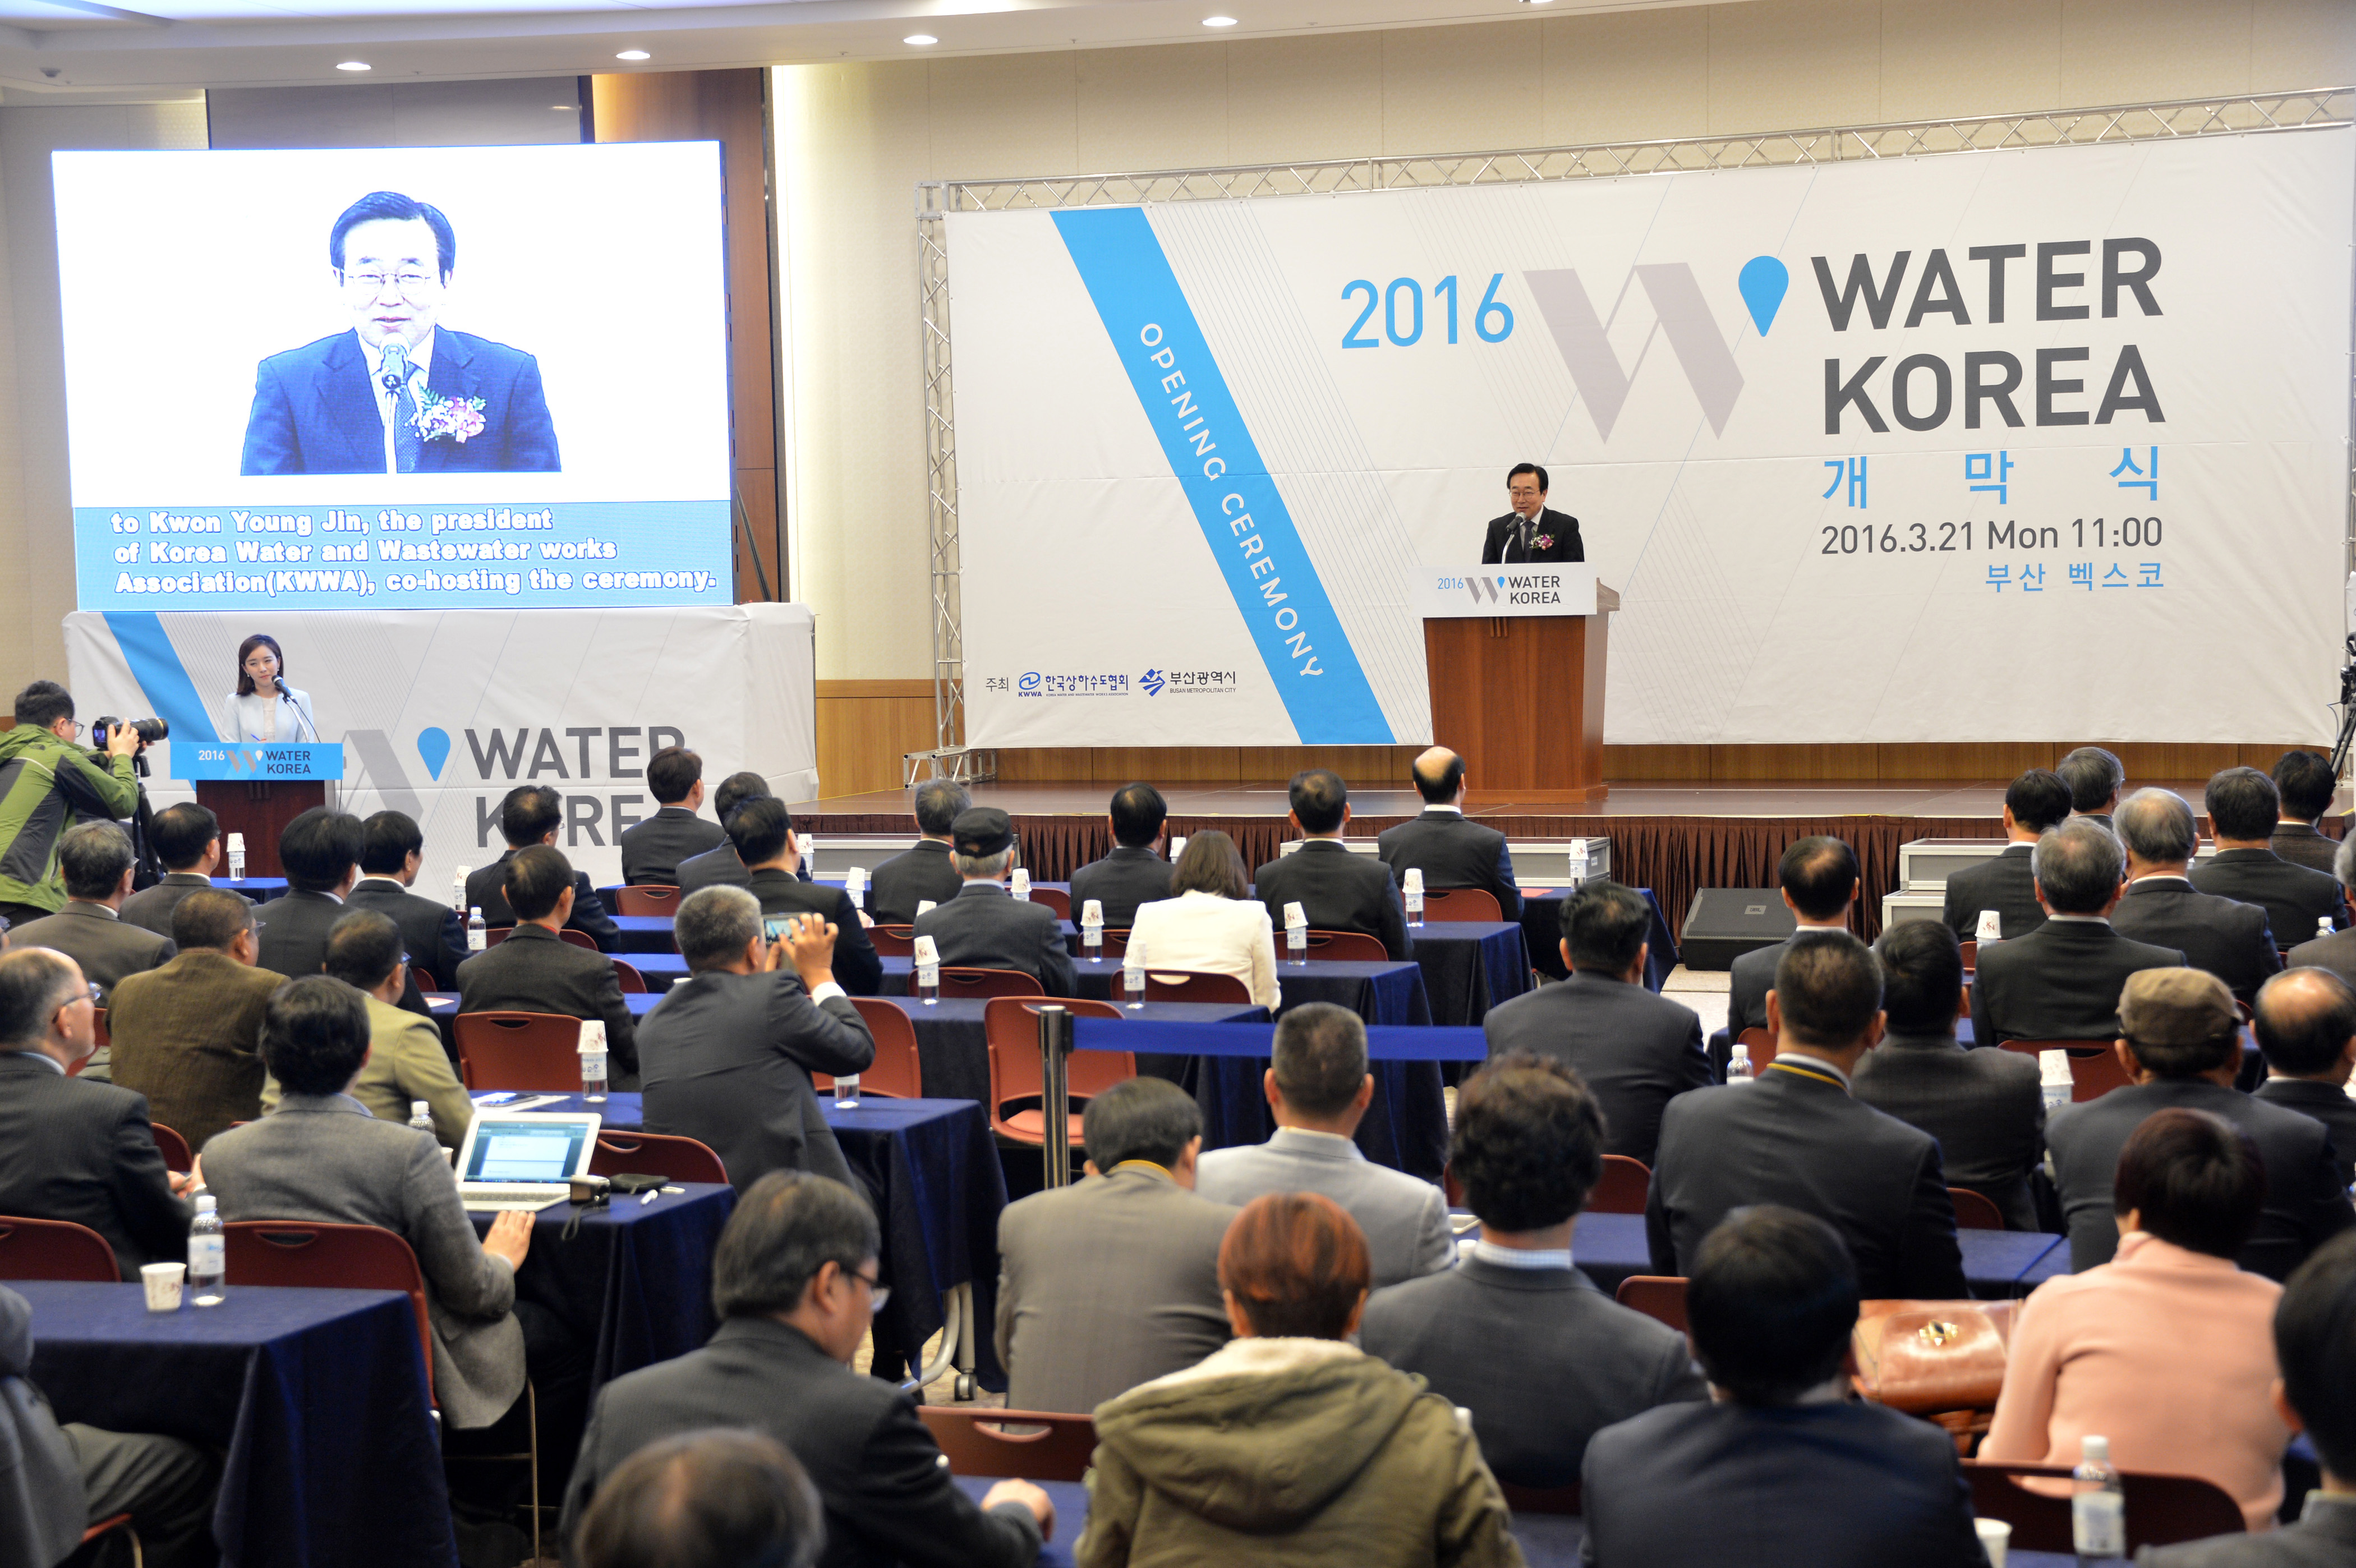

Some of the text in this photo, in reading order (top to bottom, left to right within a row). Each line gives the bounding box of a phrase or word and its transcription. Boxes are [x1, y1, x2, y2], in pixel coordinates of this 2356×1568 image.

[1810, 237, 2164, 332] WATER
[1340, 273, 1515, 349] 2016
[1824, 344, 2166, 435] KOREA
[1140, 323, 1324, 677] OPENING CEREMONY
[111, 508, 553, 537] to Kwon Young Jin, the president
[1821, 516, 2163, 555] 2016.3.21 Mon 11:00
[113, 537, 618, 564] of Korea Water and Wastewater works
[114, 568, 717, 597] Association(KWWA), co-hosting the ceremony.
[1437, 577, 1464, 590] 2016
[1508, 575, 1561, 589] WATER
[1985, 562, 2165, 594] 부산 벡스코
[1510, 591, 1561, 605] KOREA
[985, 677, 1009, 692] 주최
[1045, 674, 1129, 691] 한국상하수도협회
[1170, 671, 1236, 686] 부산광역시
[199, 749, 225, 761] 2016
[265, 750, 311, 761] WATER
[266, 763, 311, 774] KOREA
[476, 794, 645, 848] KRE
